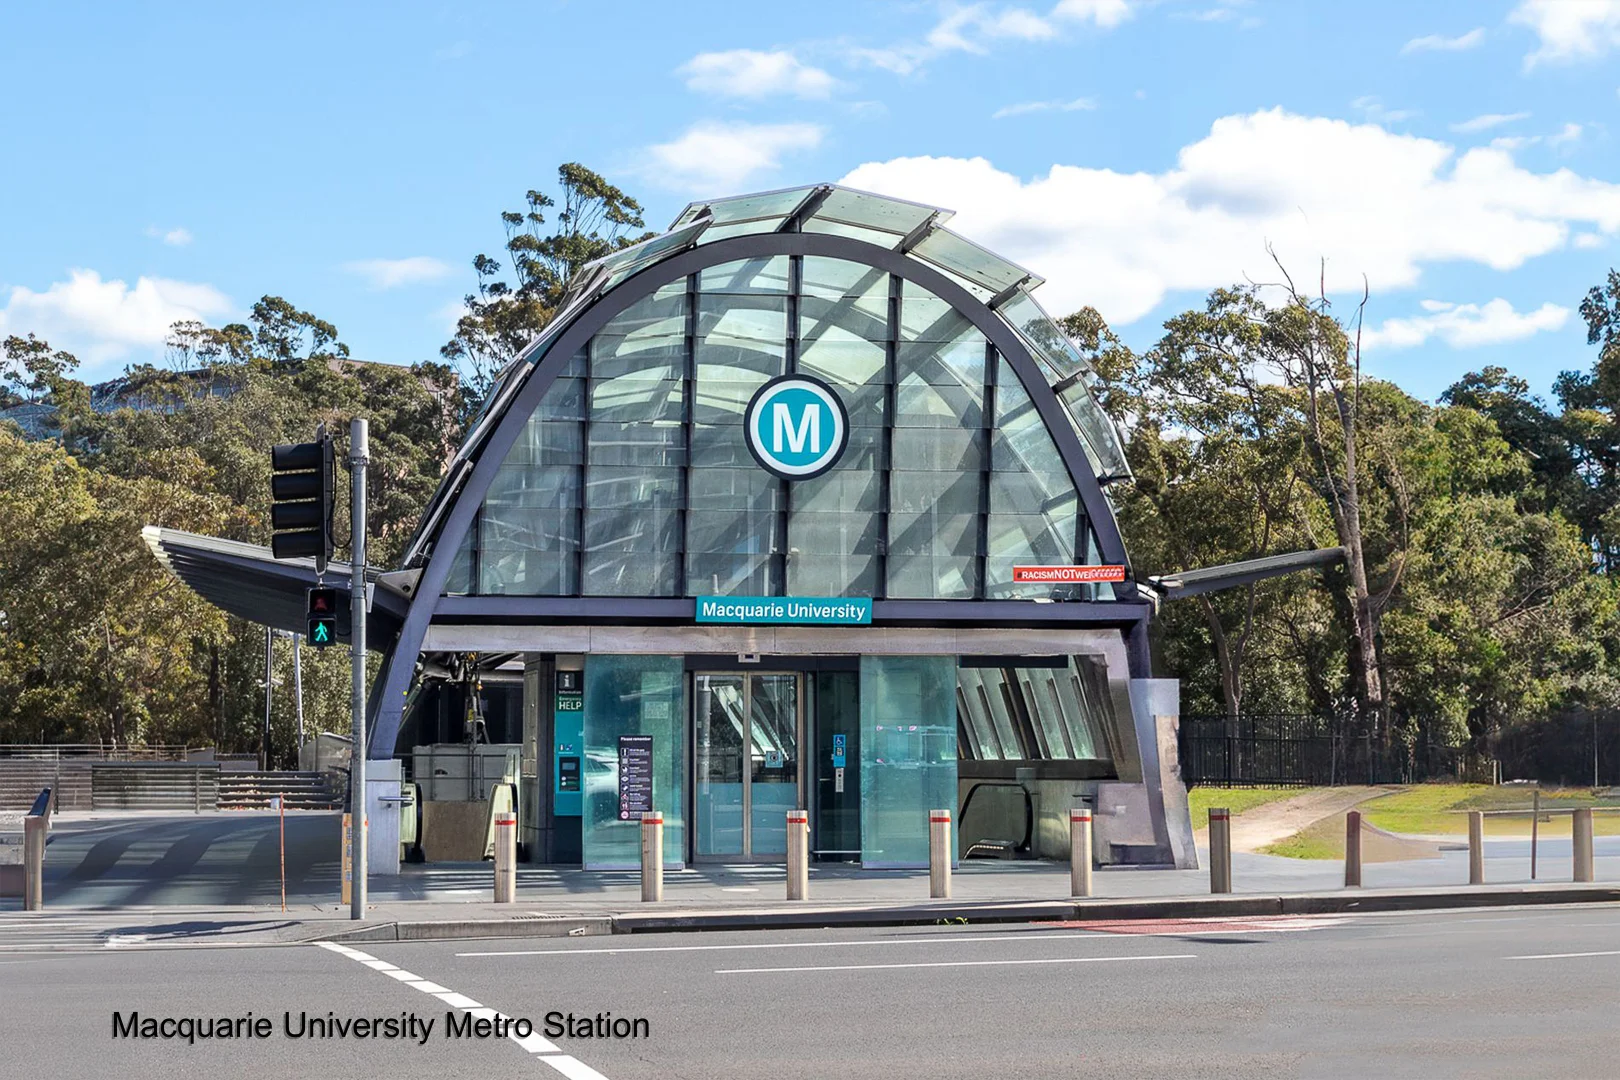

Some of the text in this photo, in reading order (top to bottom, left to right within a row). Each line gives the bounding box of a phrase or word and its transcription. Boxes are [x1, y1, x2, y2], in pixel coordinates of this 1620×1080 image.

[773, 403, 820, 453] M
[702, 602, 866, 621] Macquarie University
[558, 701, 582, 710] HELP
